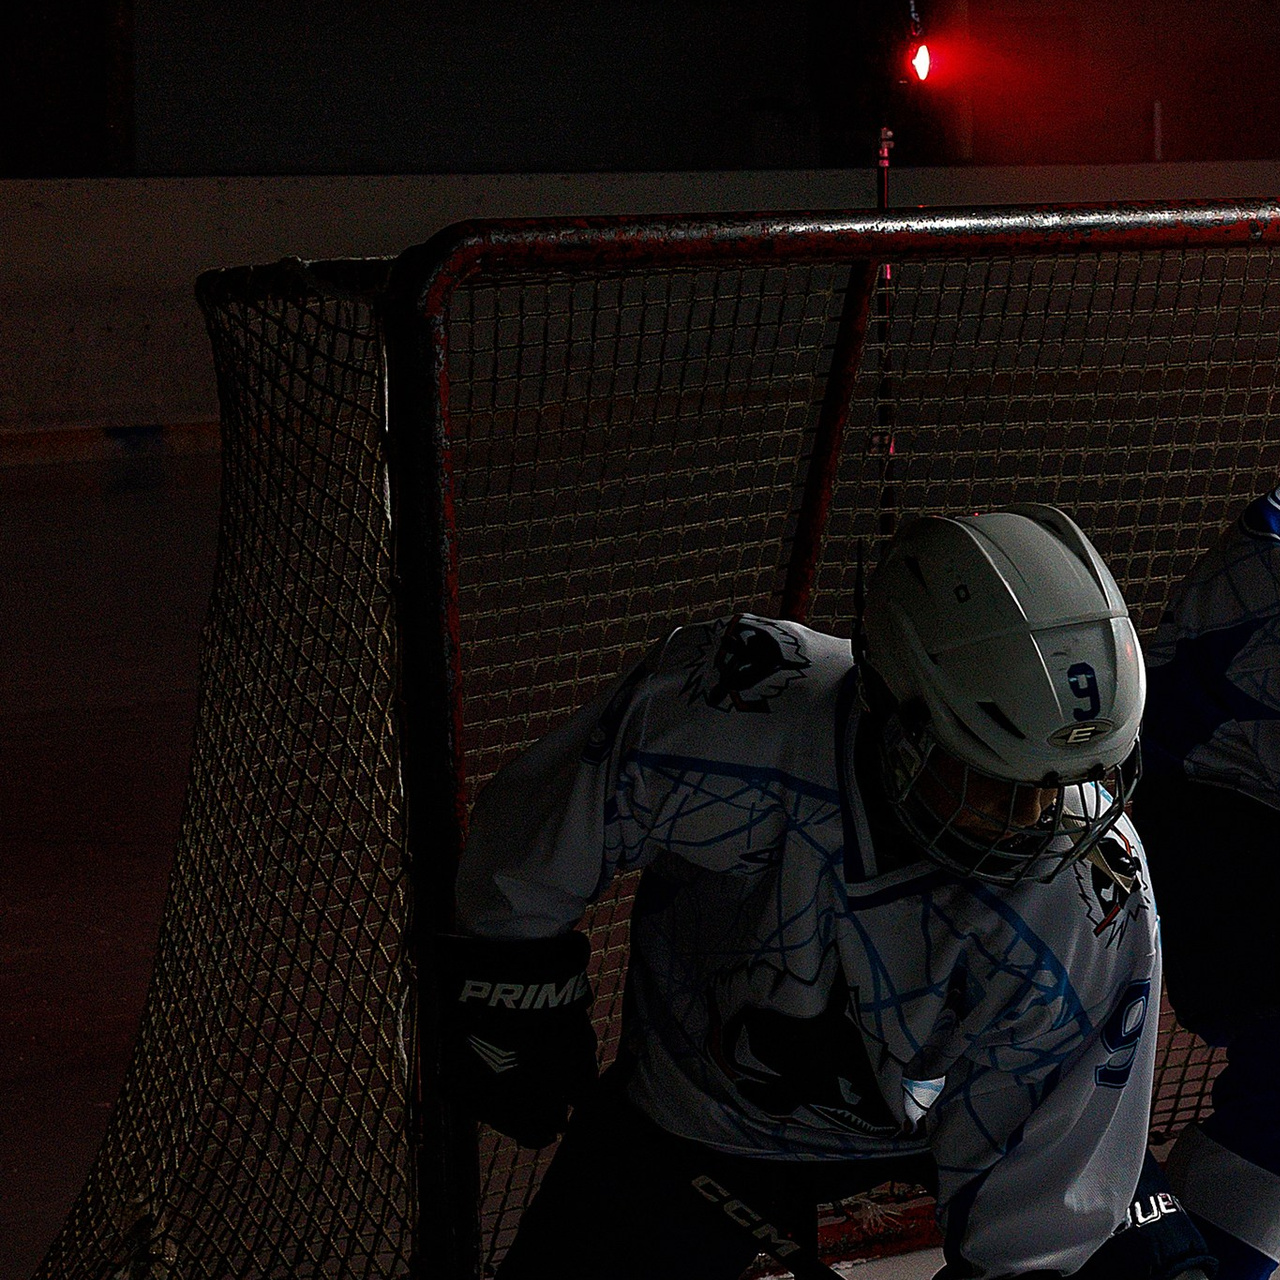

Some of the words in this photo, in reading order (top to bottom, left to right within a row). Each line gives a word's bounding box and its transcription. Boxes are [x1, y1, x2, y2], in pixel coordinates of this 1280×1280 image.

[1068, 662, 1101, 721] 9
[1095, 978, 1151, 1089] 9
[691, 1175, 801, 1258] CCM
